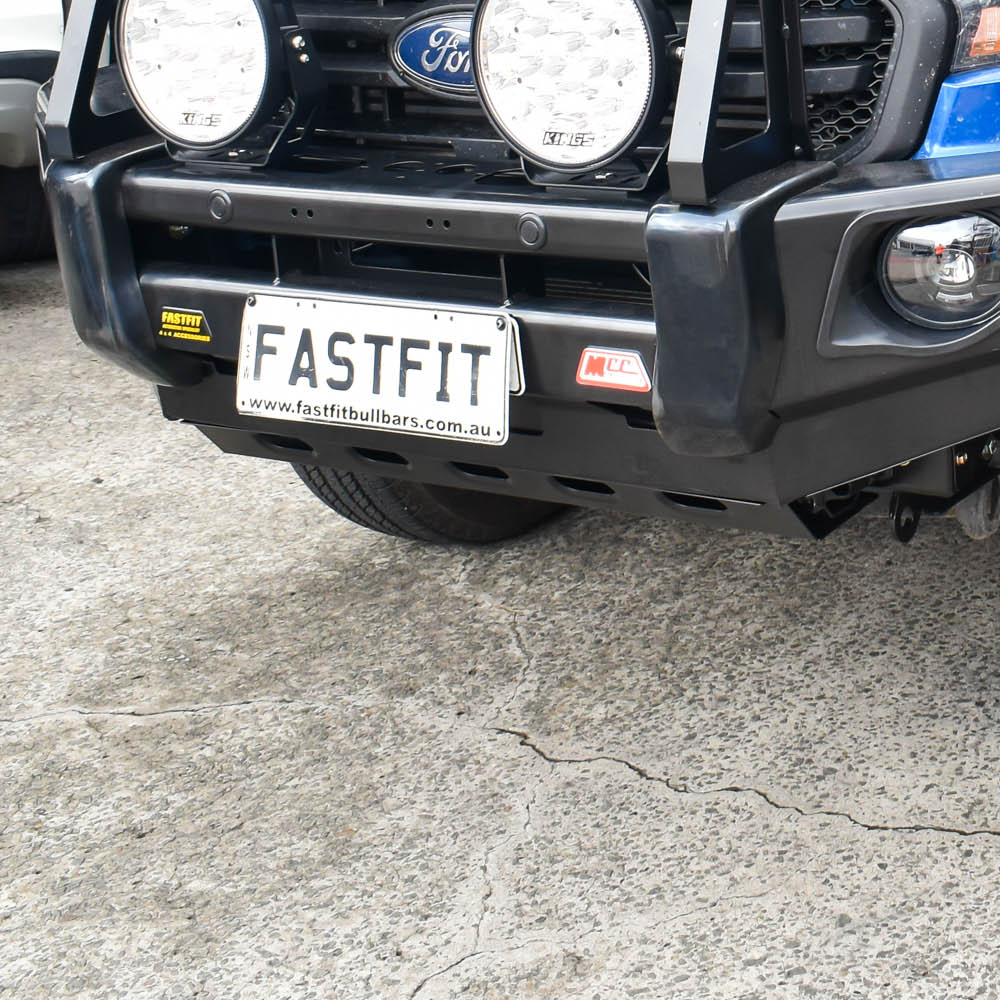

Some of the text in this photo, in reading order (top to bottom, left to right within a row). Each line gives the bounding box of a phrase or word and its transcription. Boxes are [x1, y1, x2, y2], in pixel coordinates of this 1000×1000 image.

[421, 27, 470, 73] For
[543, 131, 596, 147] KINGS
[161, 311, 203, 327] FASTFIT
[253, 323, 492, 406] FASTFIT
[249, 398, 492, 437] www.fastfitbullbars.com.au
